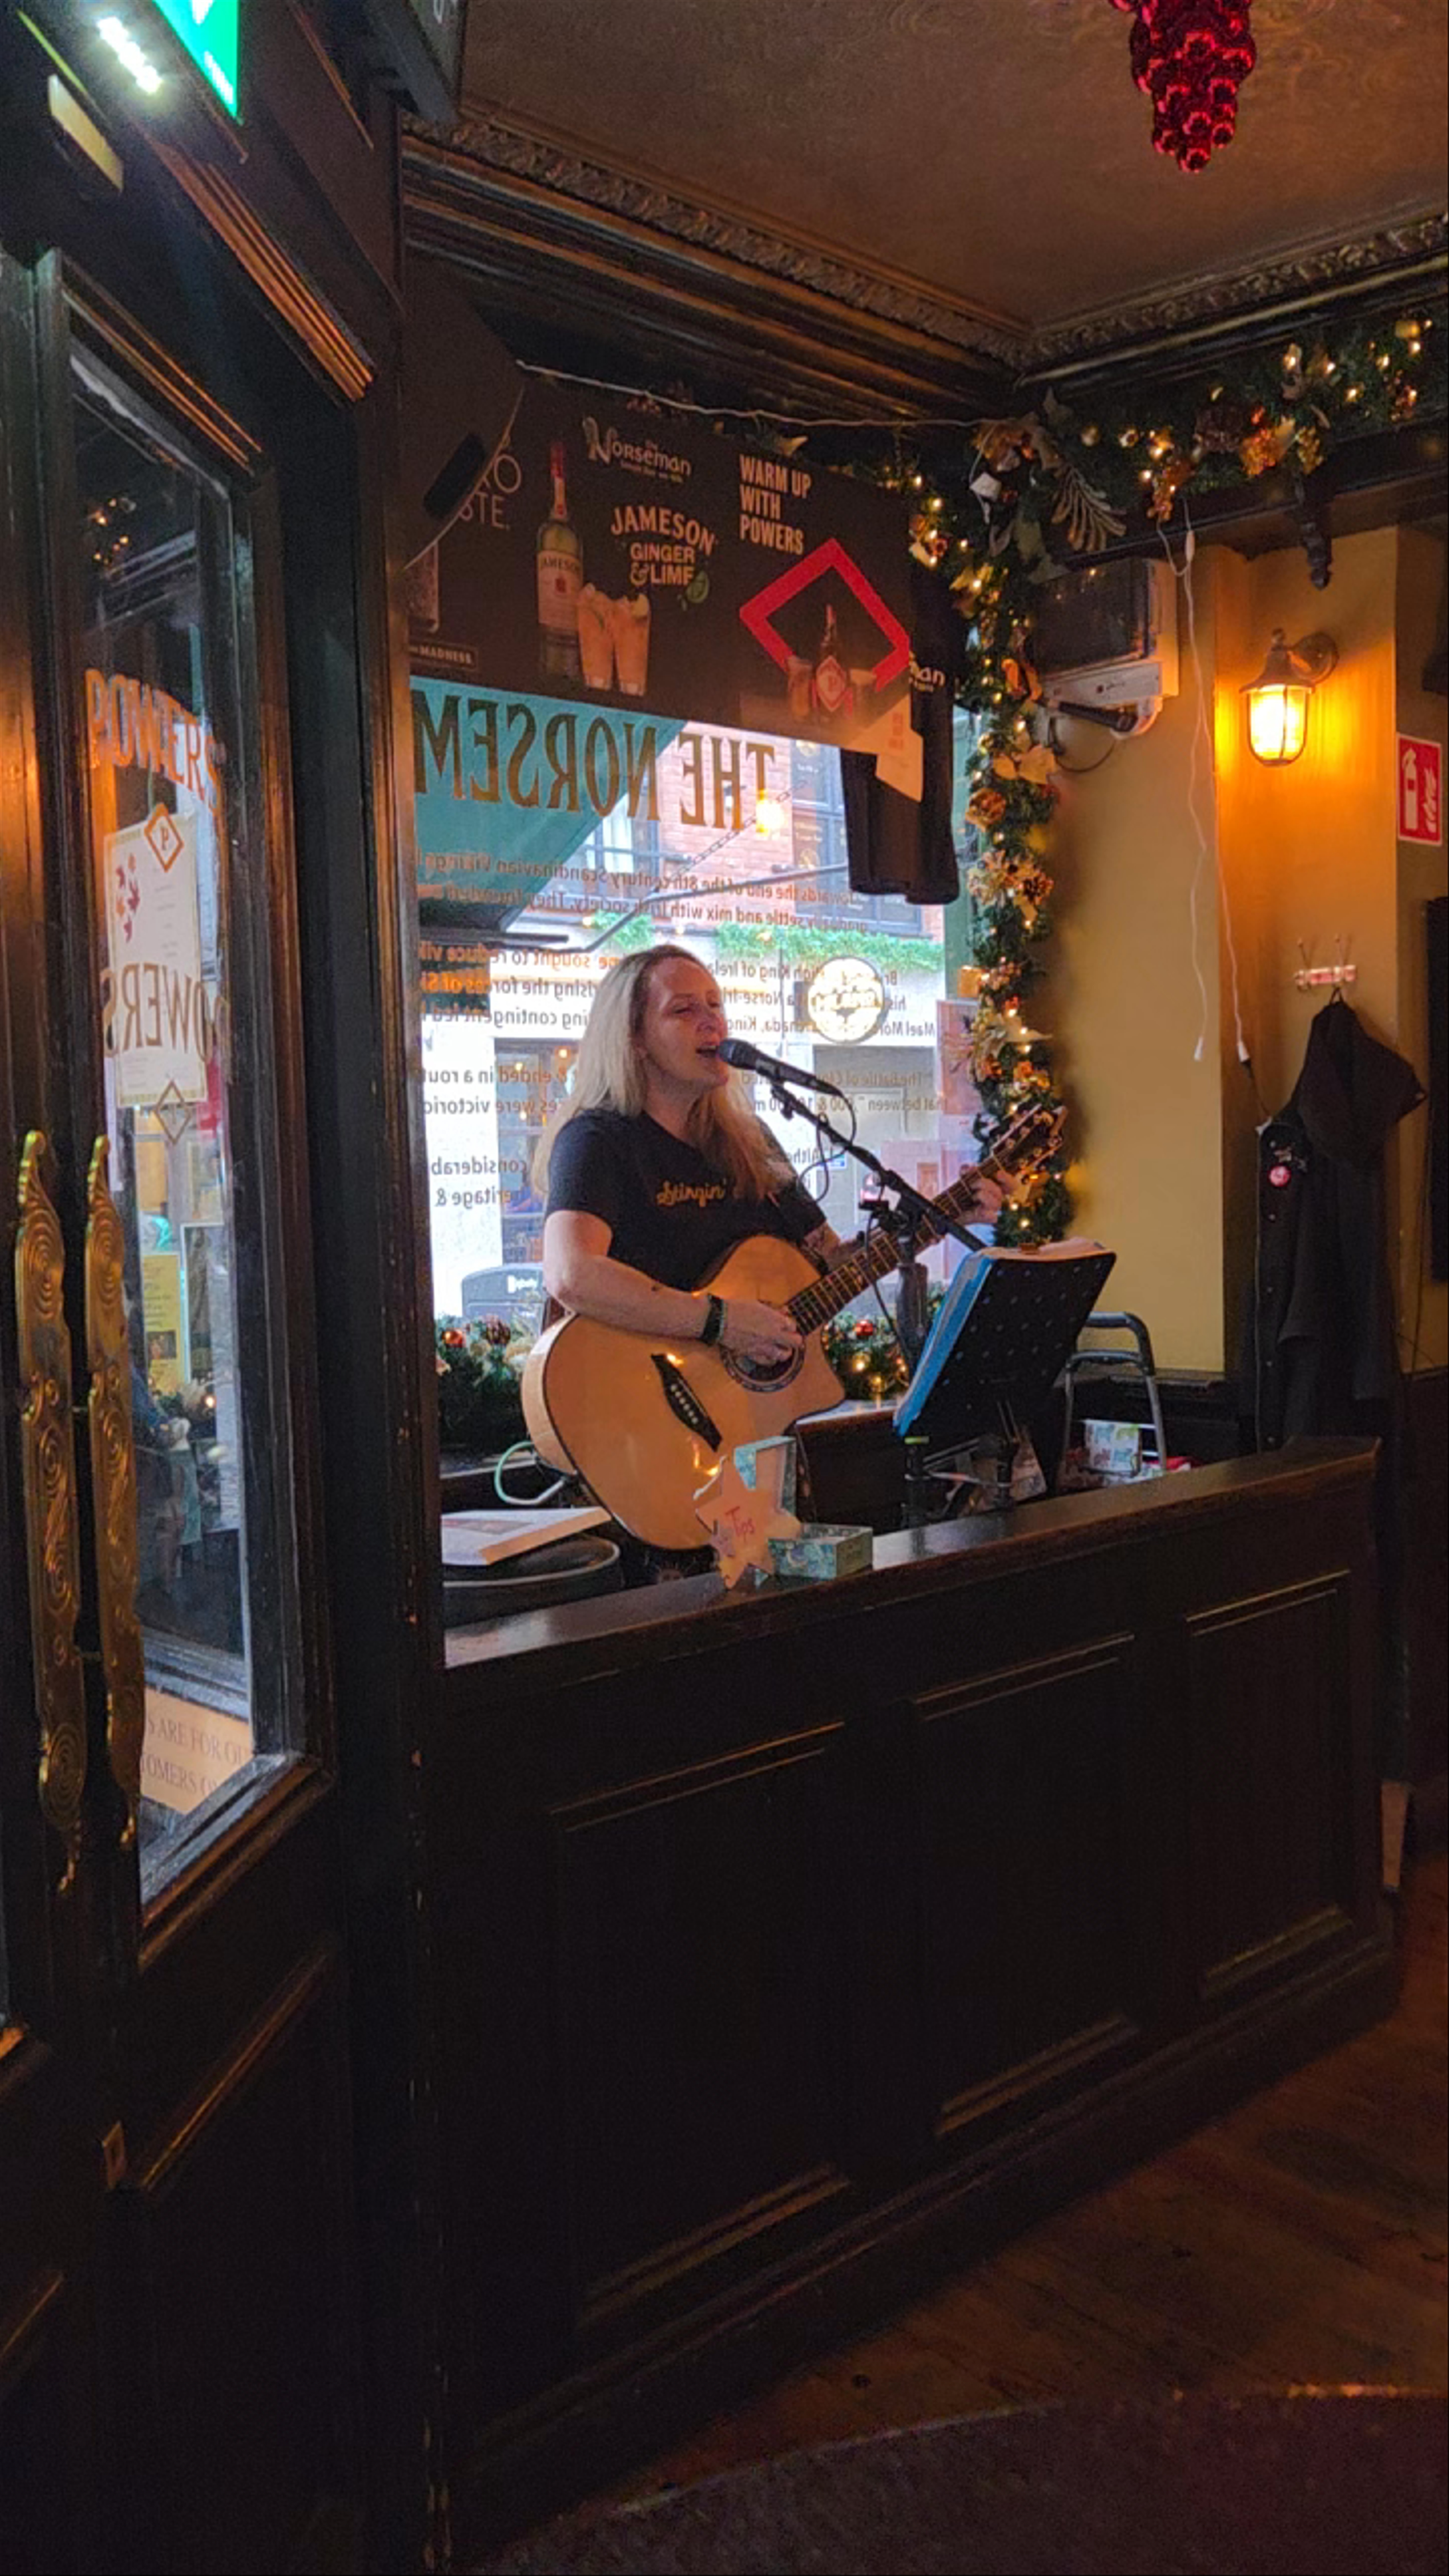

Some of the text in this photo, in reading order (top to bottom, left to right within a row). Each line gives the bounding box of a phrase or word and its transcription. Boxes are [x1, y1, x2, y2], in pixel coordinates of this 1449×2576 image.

[582, 417, 692, 477] Norseman
[739, 454, 811, 499] WARM UP
[739, 484, 781, 521] WITH
[611, 505, 717, 557] JAMESON
[630, 542, 694, 563] GINGER
[739, 514, 804, 555] POWERS
[158, 1717, 187, 1746] ARE
[191, 1727, 222, 1761] FOR
